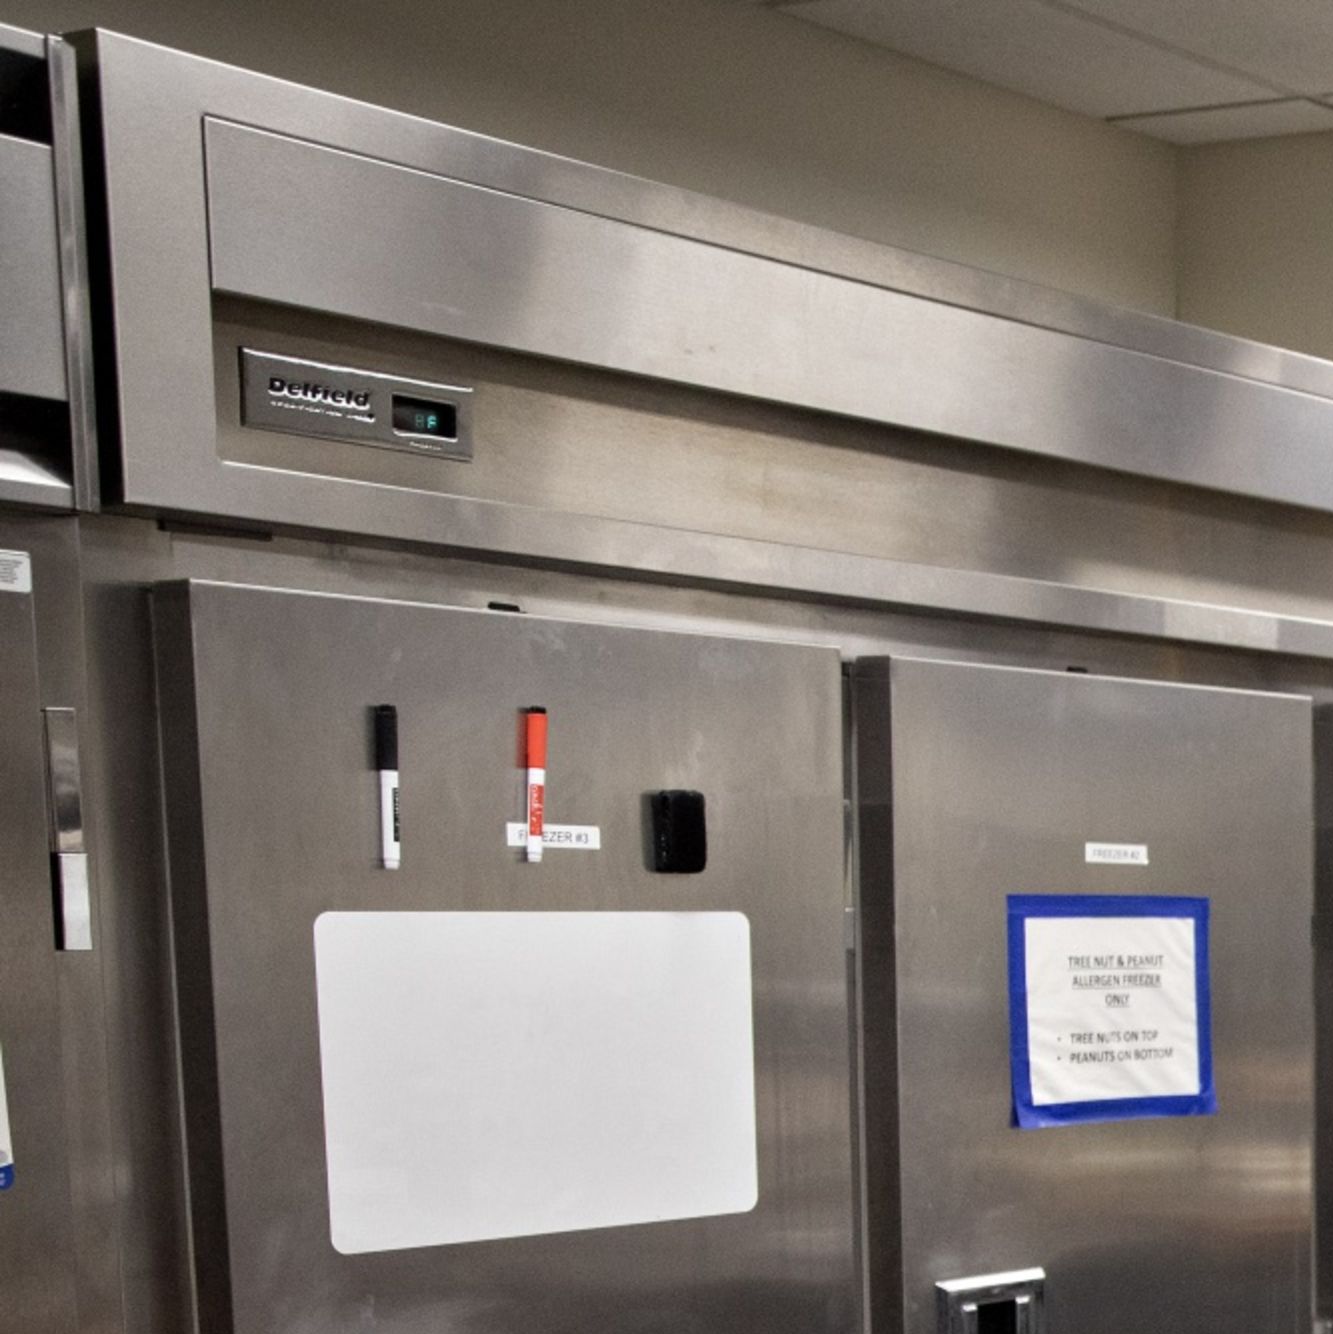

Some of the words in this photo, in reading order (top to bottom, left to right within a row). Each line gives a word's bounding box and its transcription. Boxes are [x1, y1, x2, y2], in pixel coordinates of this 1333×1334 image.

[268, 376, 371, 410] Delfield
[518, 829, 572, 843] FEZER
[1068, 955, 1091, 968] TREE
[1094, 955, 1114, 967] NUT
[1117, 955, 1125, 966] &
[1127, 954, 1164, 967] PEANUT
[1072, 974, 1120, 987] ALLERGEN
[1122, 973, 1161, 986] FREEZER
[1104, 993, 1130, 1006] ONLY
[1070, 1032, 1094, 1044] TREE
[1096, 1031, 1121, 1043] NUTS
[1123, 1030, 1139, 1042] ON
[1141, 1029, 1159, 1041] TOP
[1069, 1050, 1116, 1063] PEANUTS
[1117, 1050, 1132, 1062] ON
[1133, 1047, 1174, 1060] BOTTOM
